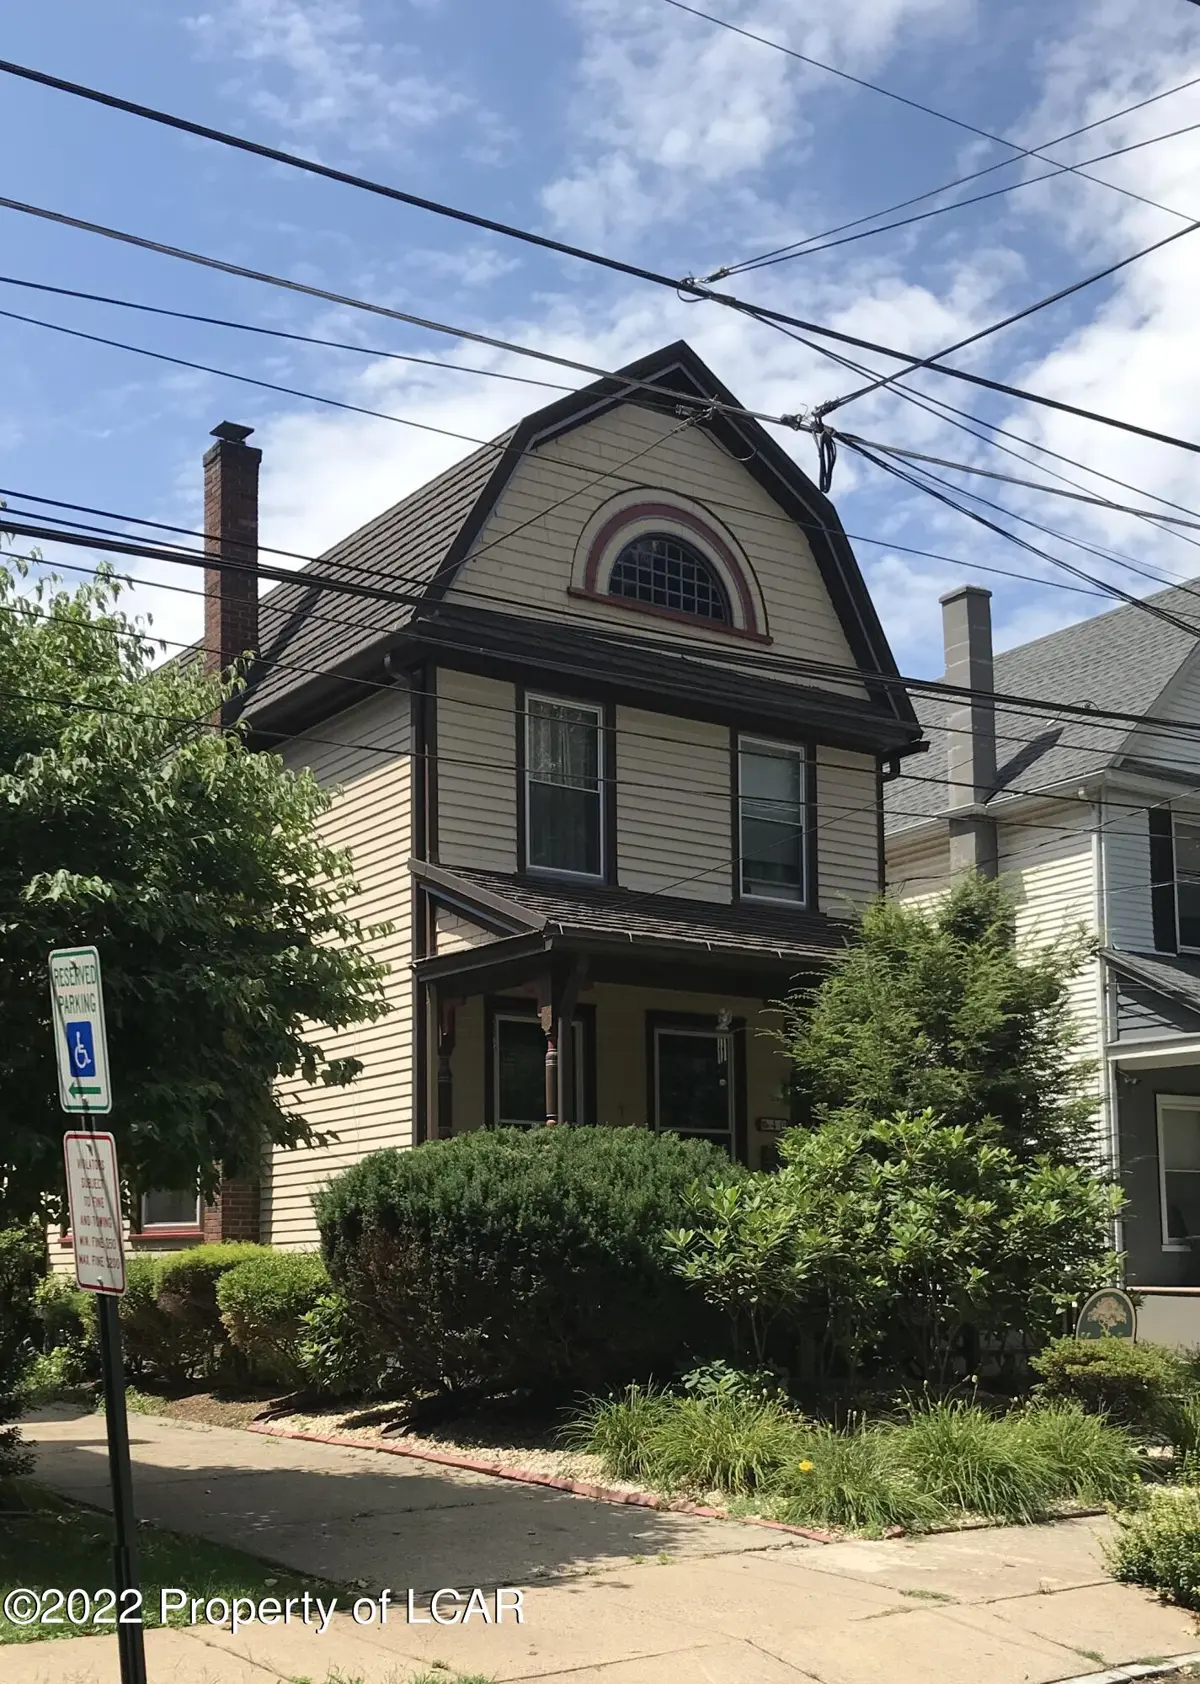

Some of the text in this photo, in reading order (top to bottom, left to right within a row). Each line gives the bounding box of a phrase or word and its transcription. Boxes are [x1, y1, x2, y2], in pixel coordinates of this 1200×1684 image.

[53, 965, 96, 987] RESERVED
[58, 993, 96, 1014] PARKING
[77, 1158, 105, 1171] VIOLATORS
[81, 1178, 104, 1190] SUBJECT
[84, 1196, 104, 1209] TO FINE
[80, 1215, 112, 1229] AND TOWING
[92, 1236, 104, 1249] FINE
[92, 1255, 105, 1268] FINE
